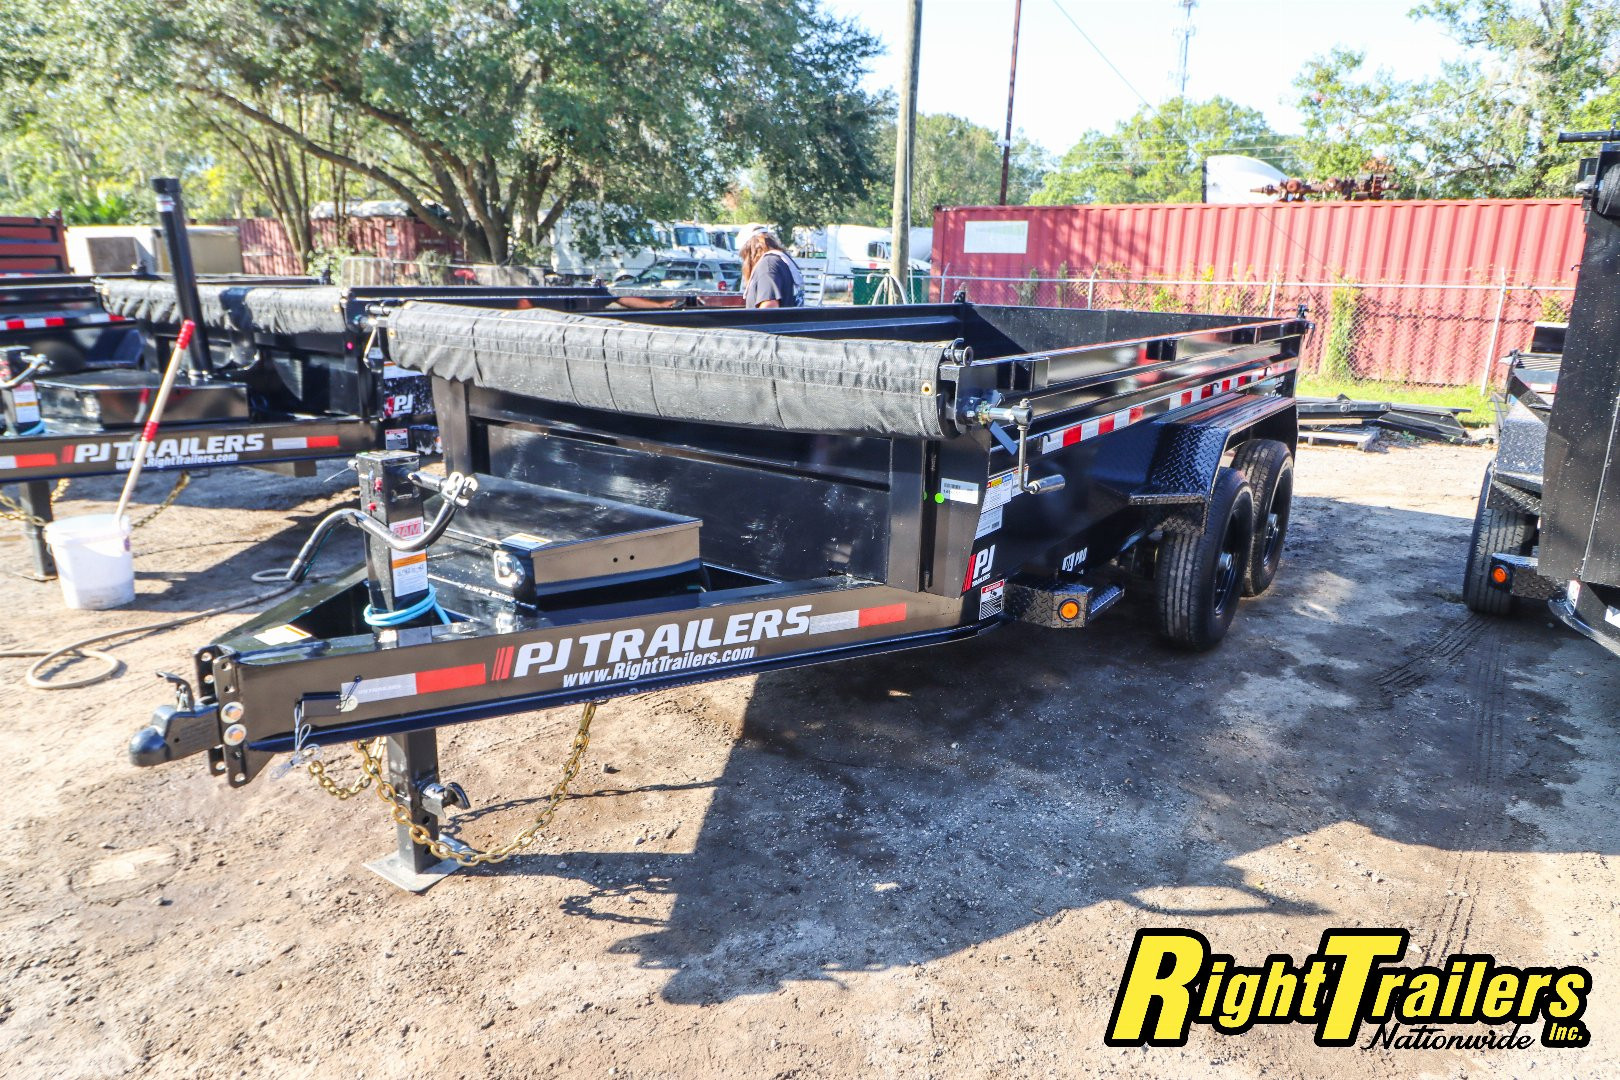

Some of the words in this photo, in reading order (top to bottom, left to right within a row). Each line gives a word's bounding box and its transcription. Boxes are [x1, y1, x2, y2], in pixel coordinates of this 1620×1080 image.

[393, 394, 413, 411] PJ
[74, 442, 111, 464] PJ
[973, 544, 996, 580] PJ
[513, 638, 573, 678] PJ
[579, 604, 813, 667] TRAILERS
[562, 646, 756, 688] www.RightTrailers.com
